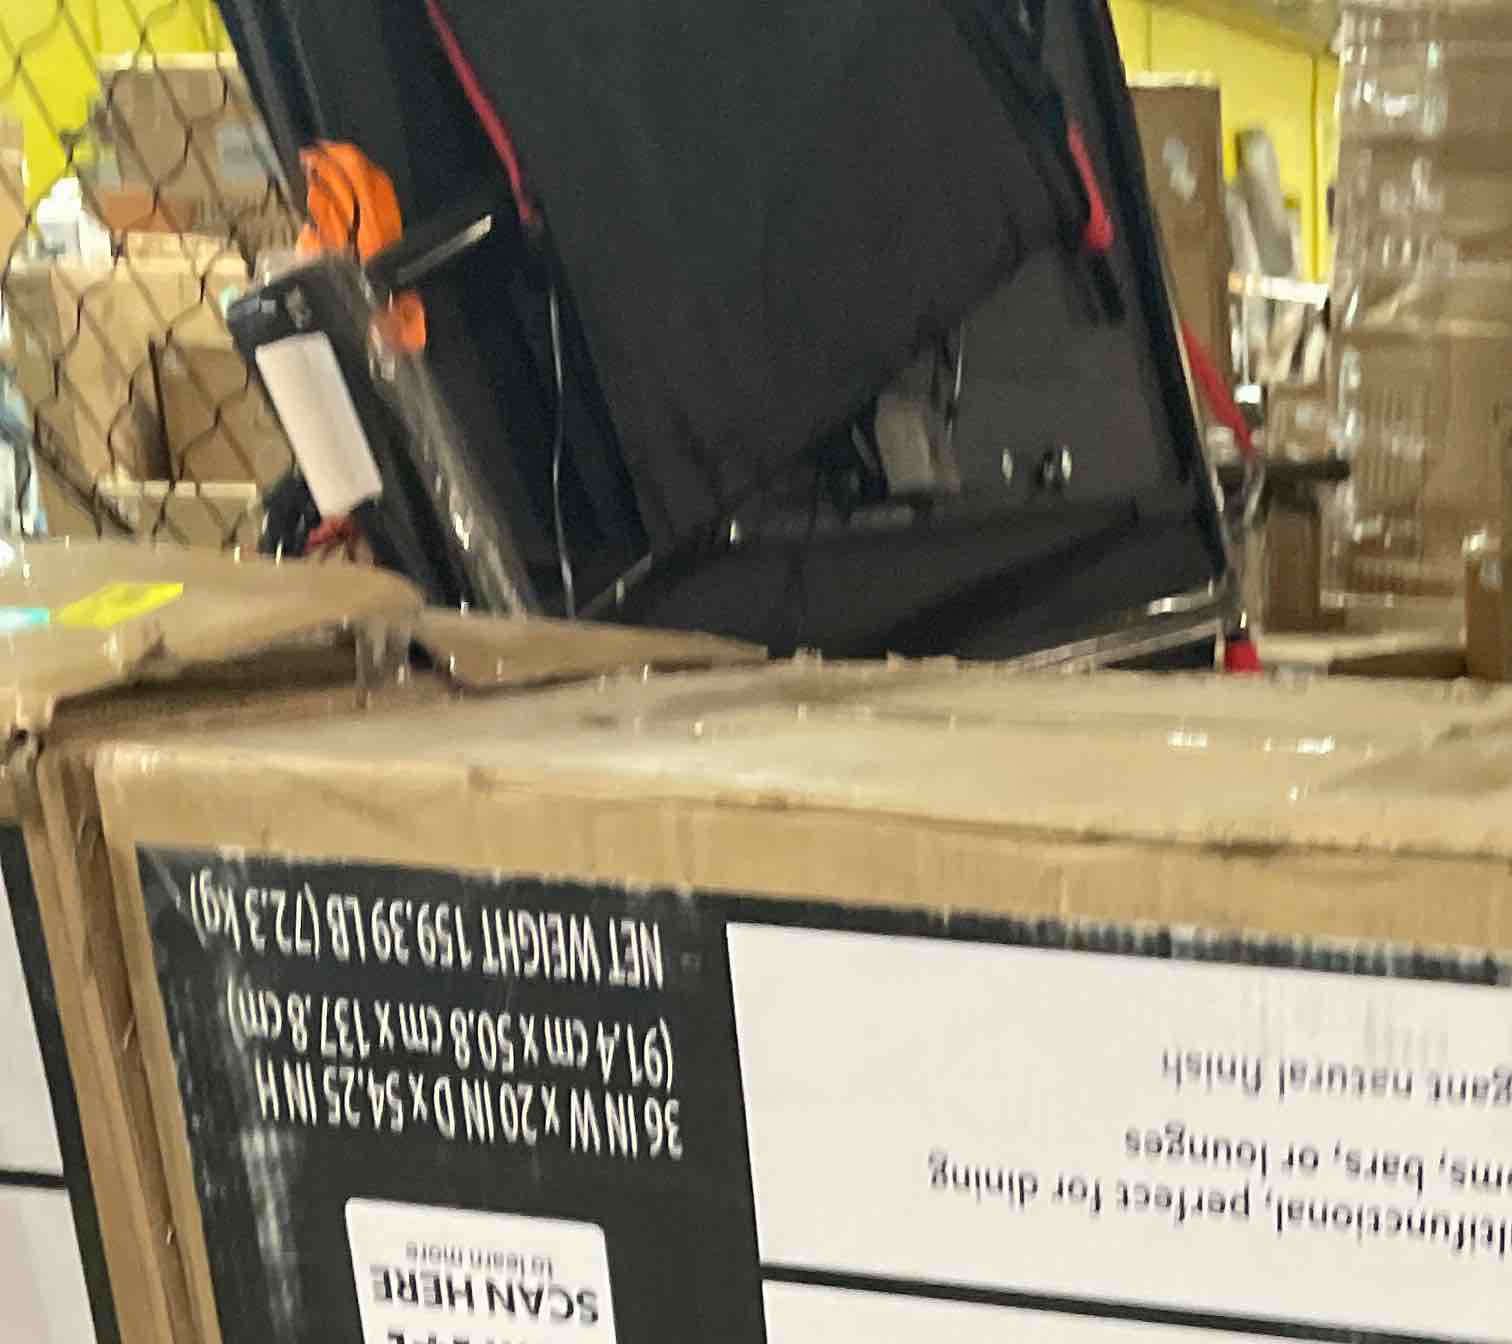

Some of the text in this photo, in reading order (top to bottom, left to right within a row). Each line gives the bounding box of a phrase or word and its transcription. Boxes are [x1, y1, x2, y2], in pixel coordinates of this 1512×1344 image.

[190, 866, 663, 989] NET WEIGHT 159.39 LB (72.3 kg)
[227, 975, 672, 1094] (91.4 cm x 50.8 cm x 137.8 cm)
[1161, 1048, 1265, 1092] finish
[1278, 1060, 1414, 1105] natural
[255, 1056, 682, 1161] 36 IN W x 20 IN D x 54.25 IN H
[1125, 1123, 1268, 1174] lounges
[1283, 1144, 1320, 1176] or
[1332, 1141, 1425, 1194] bars,
[929, 1152, 1040, 1204] dining
[1053, 1173, 1104, 1213] for
[1116, 1180, 1251, 1227] perfect
[370, 1264, 598, 1327] SCAN HERE
